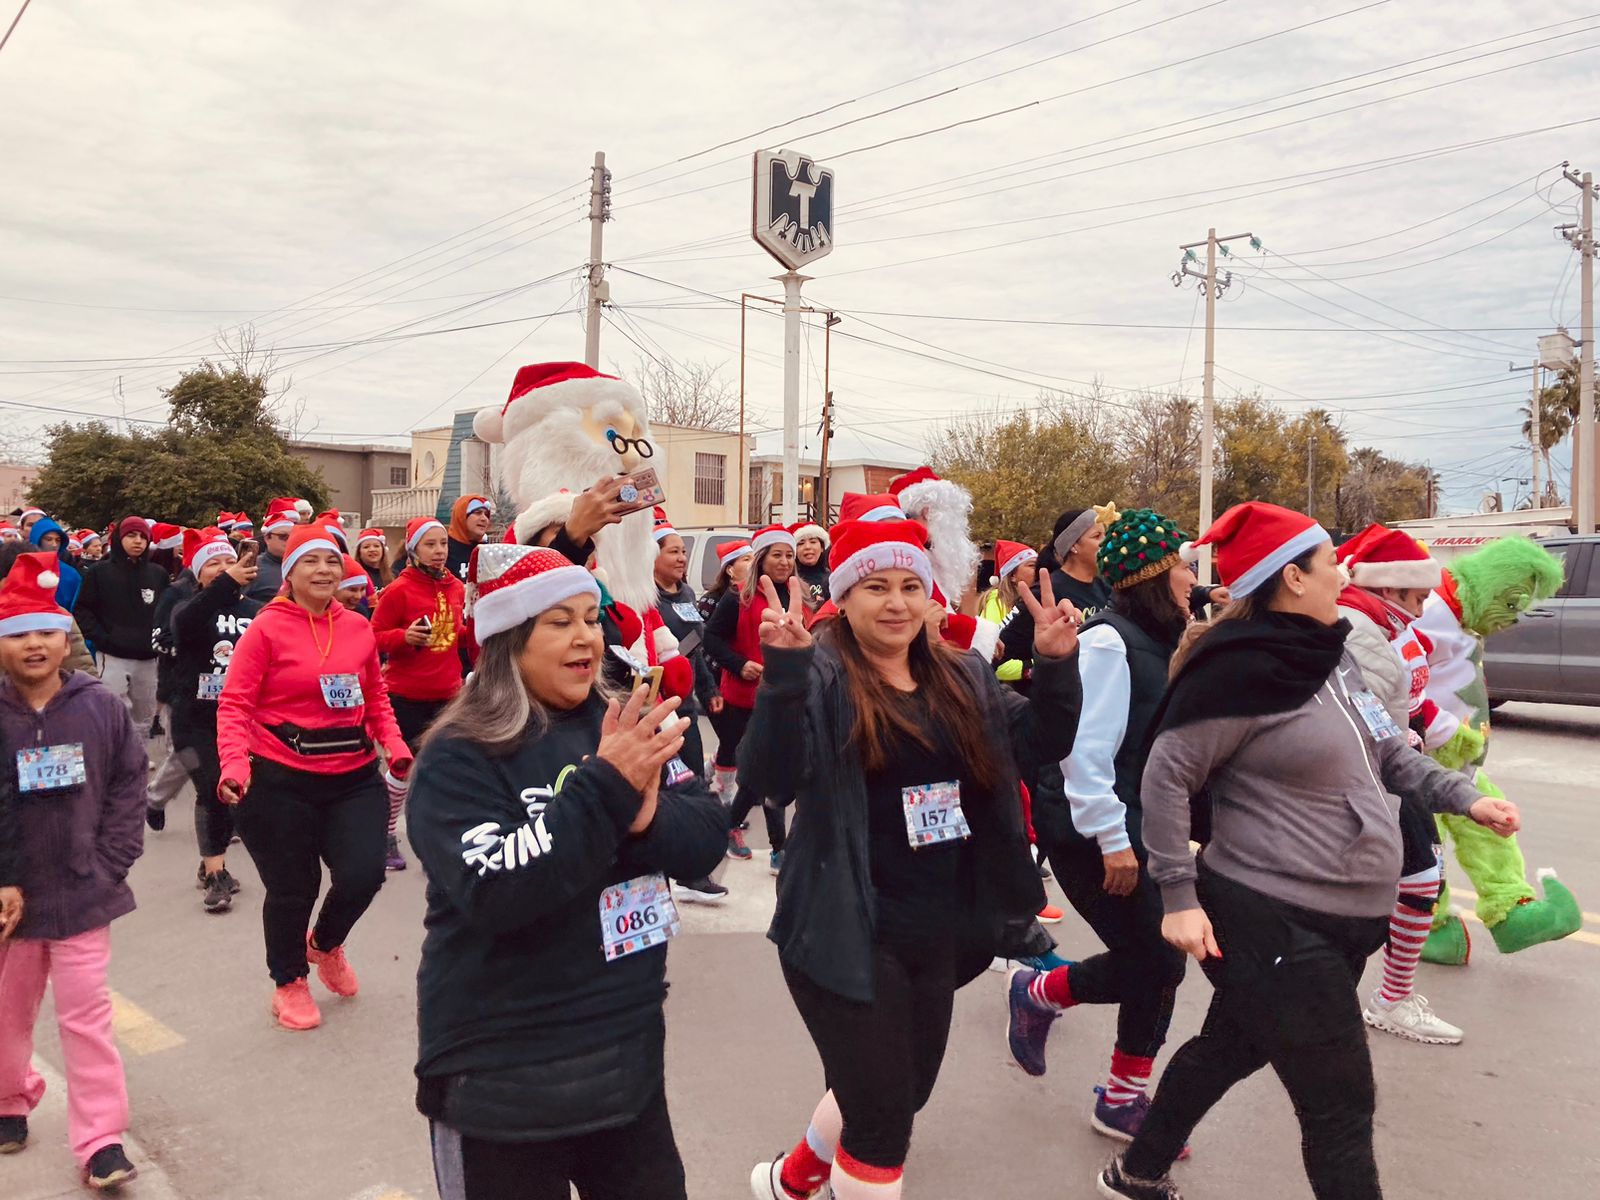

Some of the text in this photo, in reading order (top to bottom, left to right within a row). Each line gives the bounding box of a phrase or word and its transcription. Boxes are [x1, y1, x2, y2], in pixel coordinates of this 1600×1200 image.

[1432, 536, 1501, 545] MARAN
[330, 689, 352, 698] 062
[37, 764, 68, 778] 178
[921, 809, 947, 827] 157
[615, 905, 659, 934] 086
